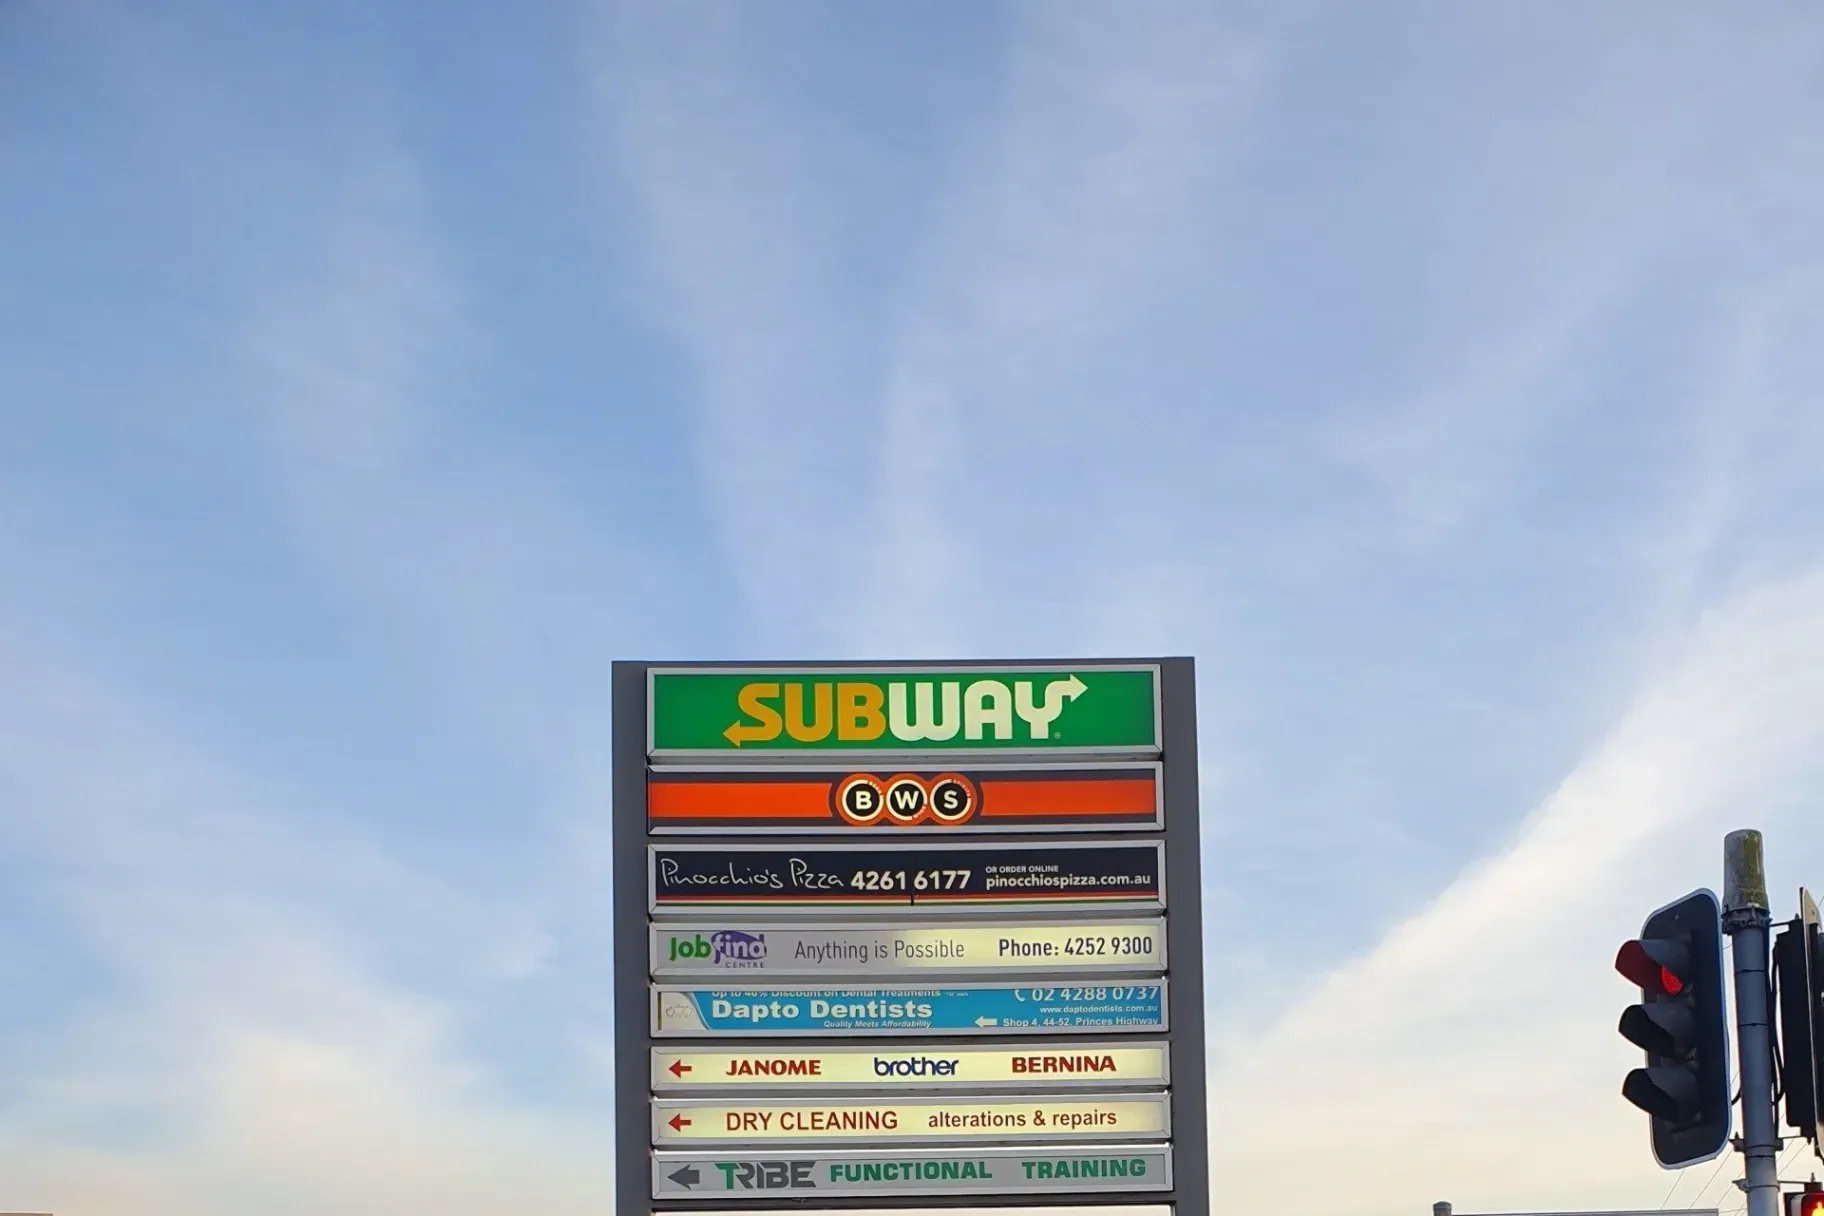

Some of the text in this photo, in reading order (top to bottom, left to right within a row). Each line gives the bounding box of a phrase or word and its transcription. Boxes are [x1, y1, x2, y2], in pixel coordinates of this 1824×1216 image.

[723, 674, 1089, 747] SUBWAY
[660, 858, 971, 890] Pinocchio's Pizza 4261 6177
[985, 865, 1059, 874] OR ORDER ONLINE
[985, 873, 1151, 891] pinocchiospizza.com.au
[794, 936, 1152, 964] Anything is Possible Phone: 4252 9300
[1032, 987, 1159, 1002] 02 4288 0737
[712, 1000, 933, 1023] Dapto Dentists
[1040, 1005, 1158, 1014] www.daptodentists.com.au
[823, 1020, 932, 1028] Quality Meets Affordability
[1003, 1018, 1029, 1027] Shop
[1075, 1017, 1113, 1026] Princes
[1116, 1016, 1159, 1026] Highway
[726, 1055, 1117, 1077] JANOME brother BERNINA
[726, 1109, 1117, 1131] DRY CLEANING alterations & repairs
[714, 1159, 1146, 1190] TRIBE FUNCTIONAL TRAINING
